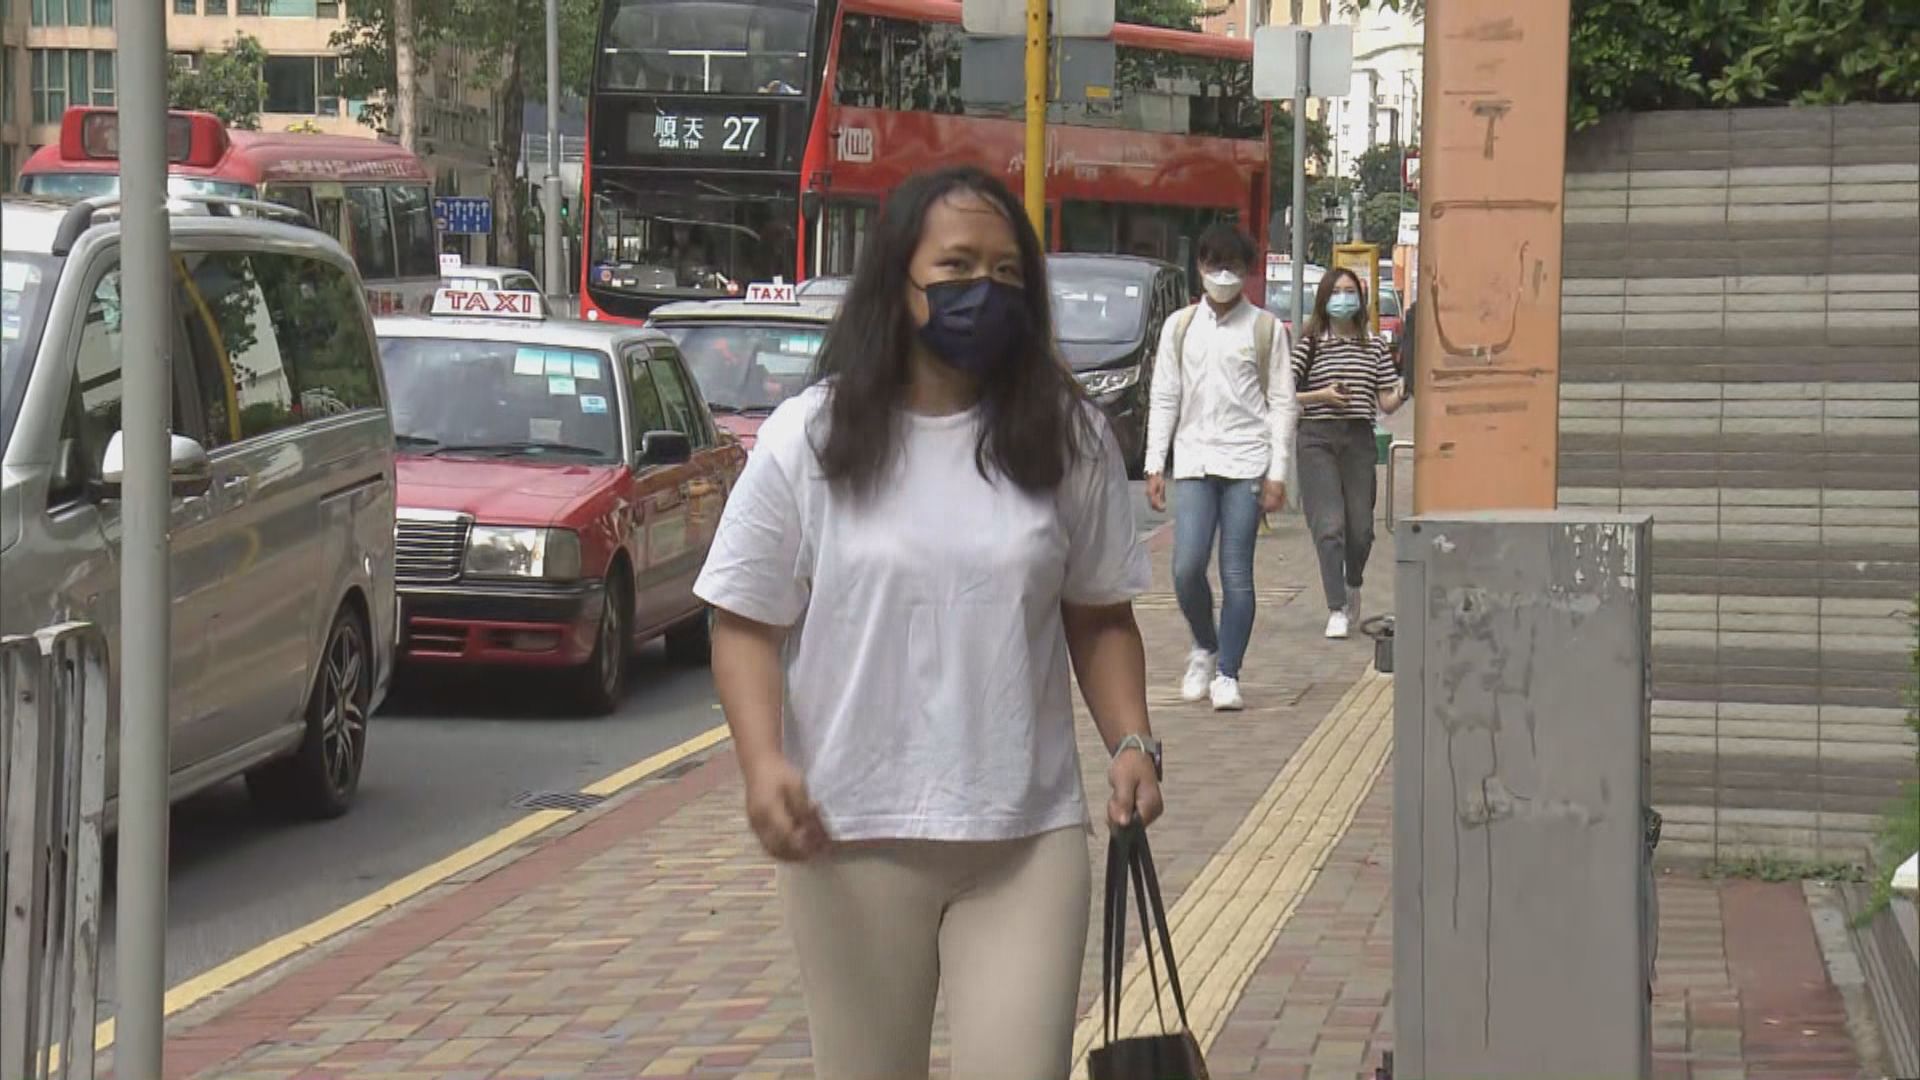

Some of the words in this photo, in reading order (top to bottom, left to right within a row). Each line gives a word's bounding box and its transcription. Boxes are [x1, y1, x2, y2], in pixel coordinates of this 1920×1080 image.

[653, 115, 704, 139] 順天
[722, 116, 760, 150] 27
[684, 139, 700, 149] TIN
[838, 127, 873, 163] KMB
[445, 290, 531, 313] TAXI
[751, 287, 791, 300] TAXI
